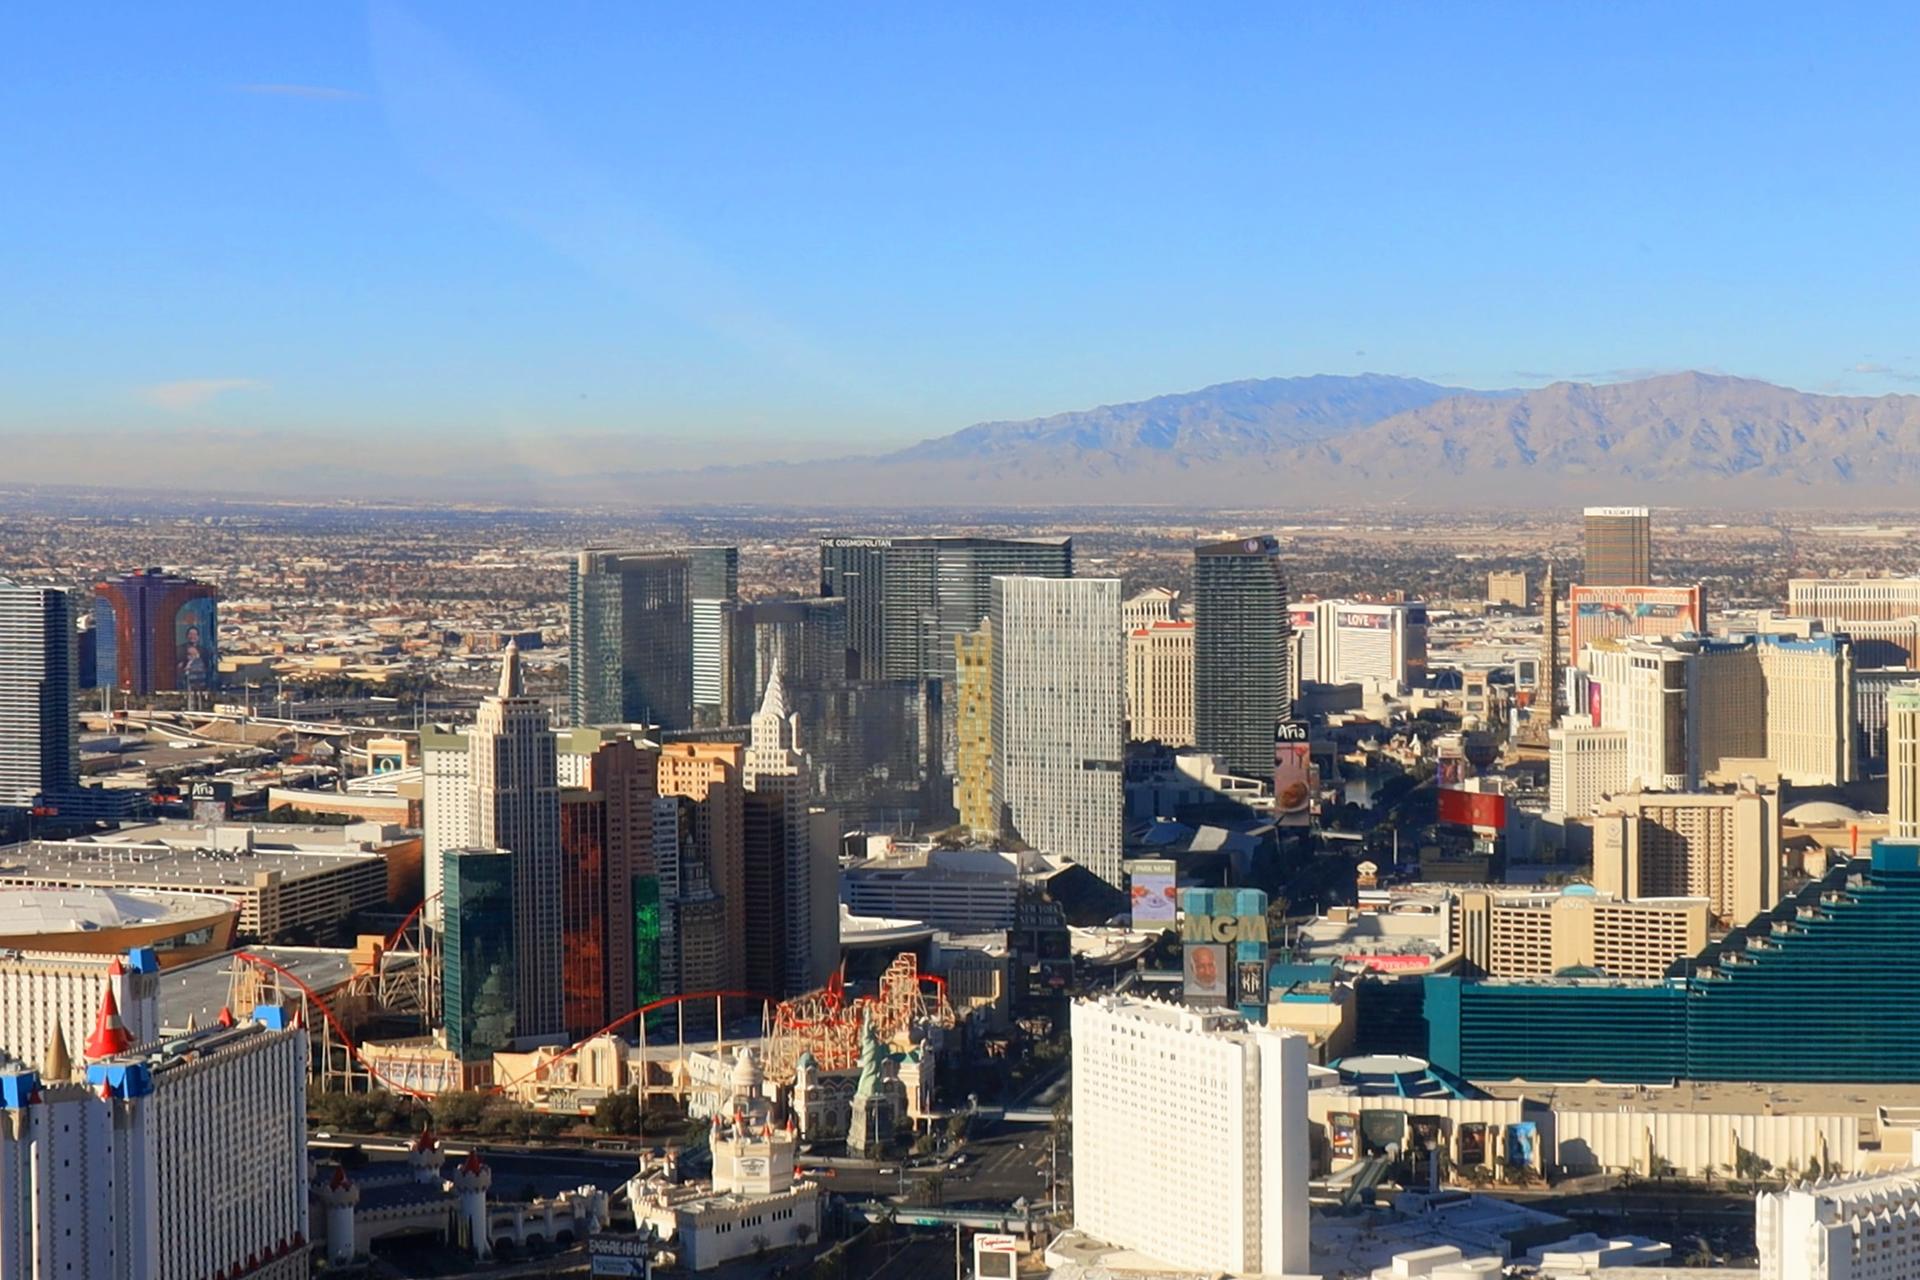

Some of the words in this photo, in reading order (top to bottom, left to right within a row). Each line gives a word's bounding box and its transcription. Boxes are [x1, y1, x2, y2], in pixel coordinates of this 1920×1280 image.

[820, 539, 834, 548] THE
[836, 539, 892, 548] COSMOPOLITAN
[1347, 614, 1370, 626] LOVE
[1020, 904, 1037, 913] NEW
[1038, 904, 1058, 914] YORK
[1020, 916, 1037, 925] NEW
[1038, 916, 1059, 926] YORK
[1182, 915, 1269, 943] MGM
[589, 1239, 649, 1257] EXCALIBUR
